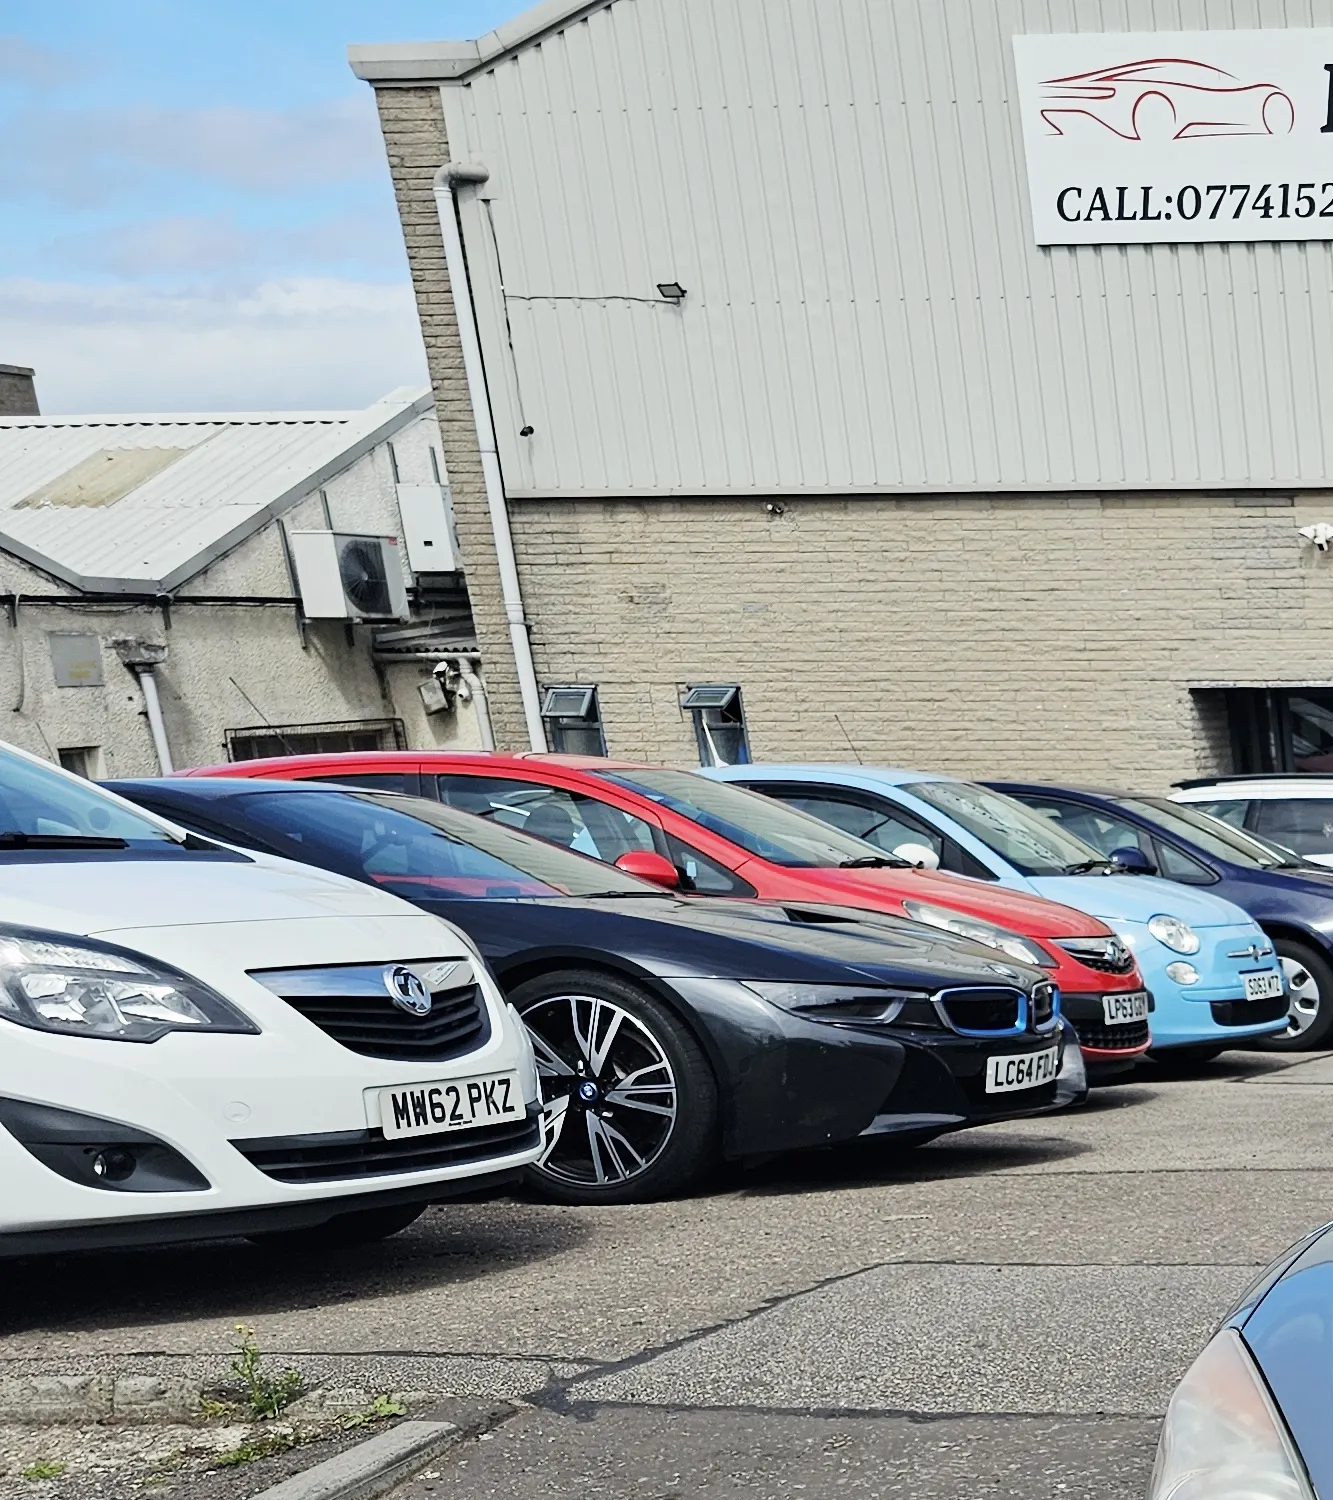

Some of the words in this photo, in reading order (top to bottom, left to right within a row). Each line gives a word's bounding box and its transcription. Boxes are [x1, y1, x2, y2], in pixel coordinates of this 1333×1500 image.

[1108, 997, 1133, 1020] LP63
[994, 1058, 1034, 1087] LC64
[391, 1085, 464, 1130] MW62
[467, 1077, 515, 1118] PKZ
